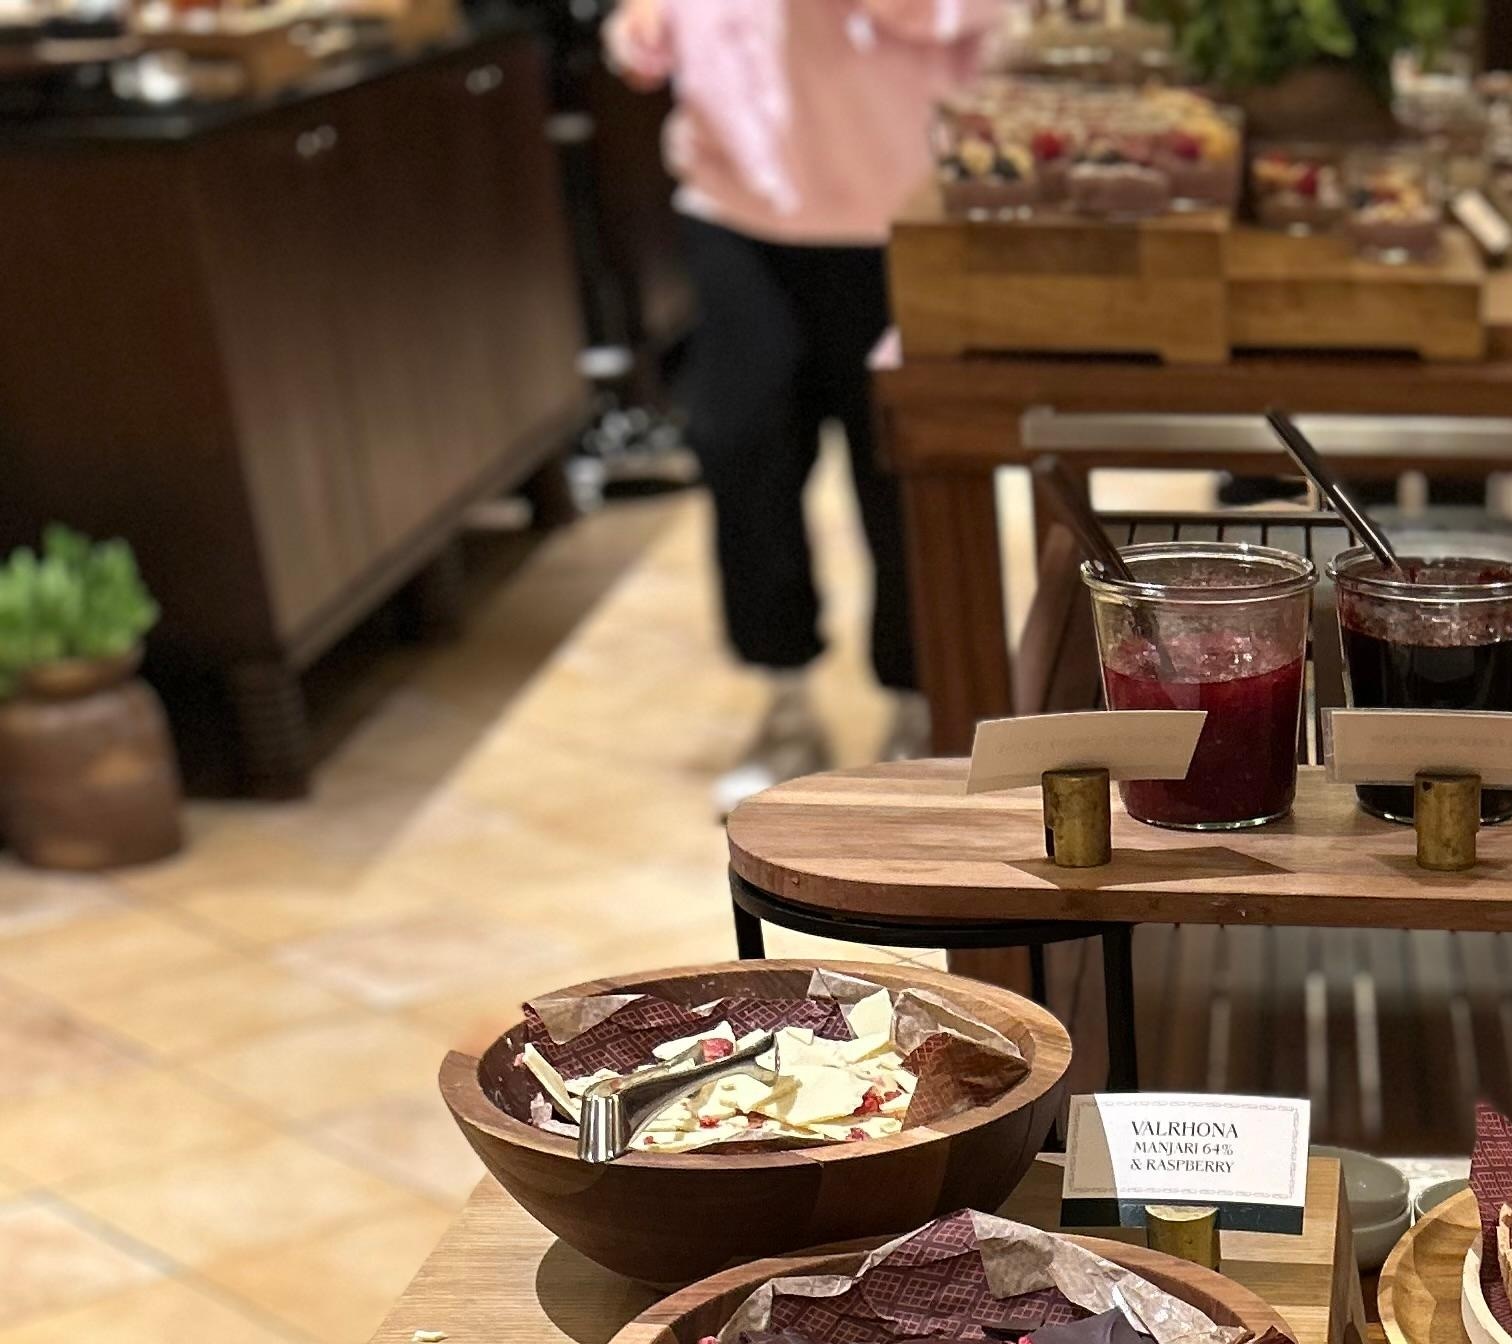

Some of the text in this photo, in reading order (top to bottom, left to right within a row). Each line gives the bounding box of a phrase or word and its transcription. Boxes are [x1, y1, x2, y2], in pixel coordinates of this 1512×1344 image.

[1131, 1120, 1239, 1139] VALRHONA
[1133, 1141, 1234, 1156] MANJARI 64%
[1130, 1158, 1235, 1173] & RASPBERRY
